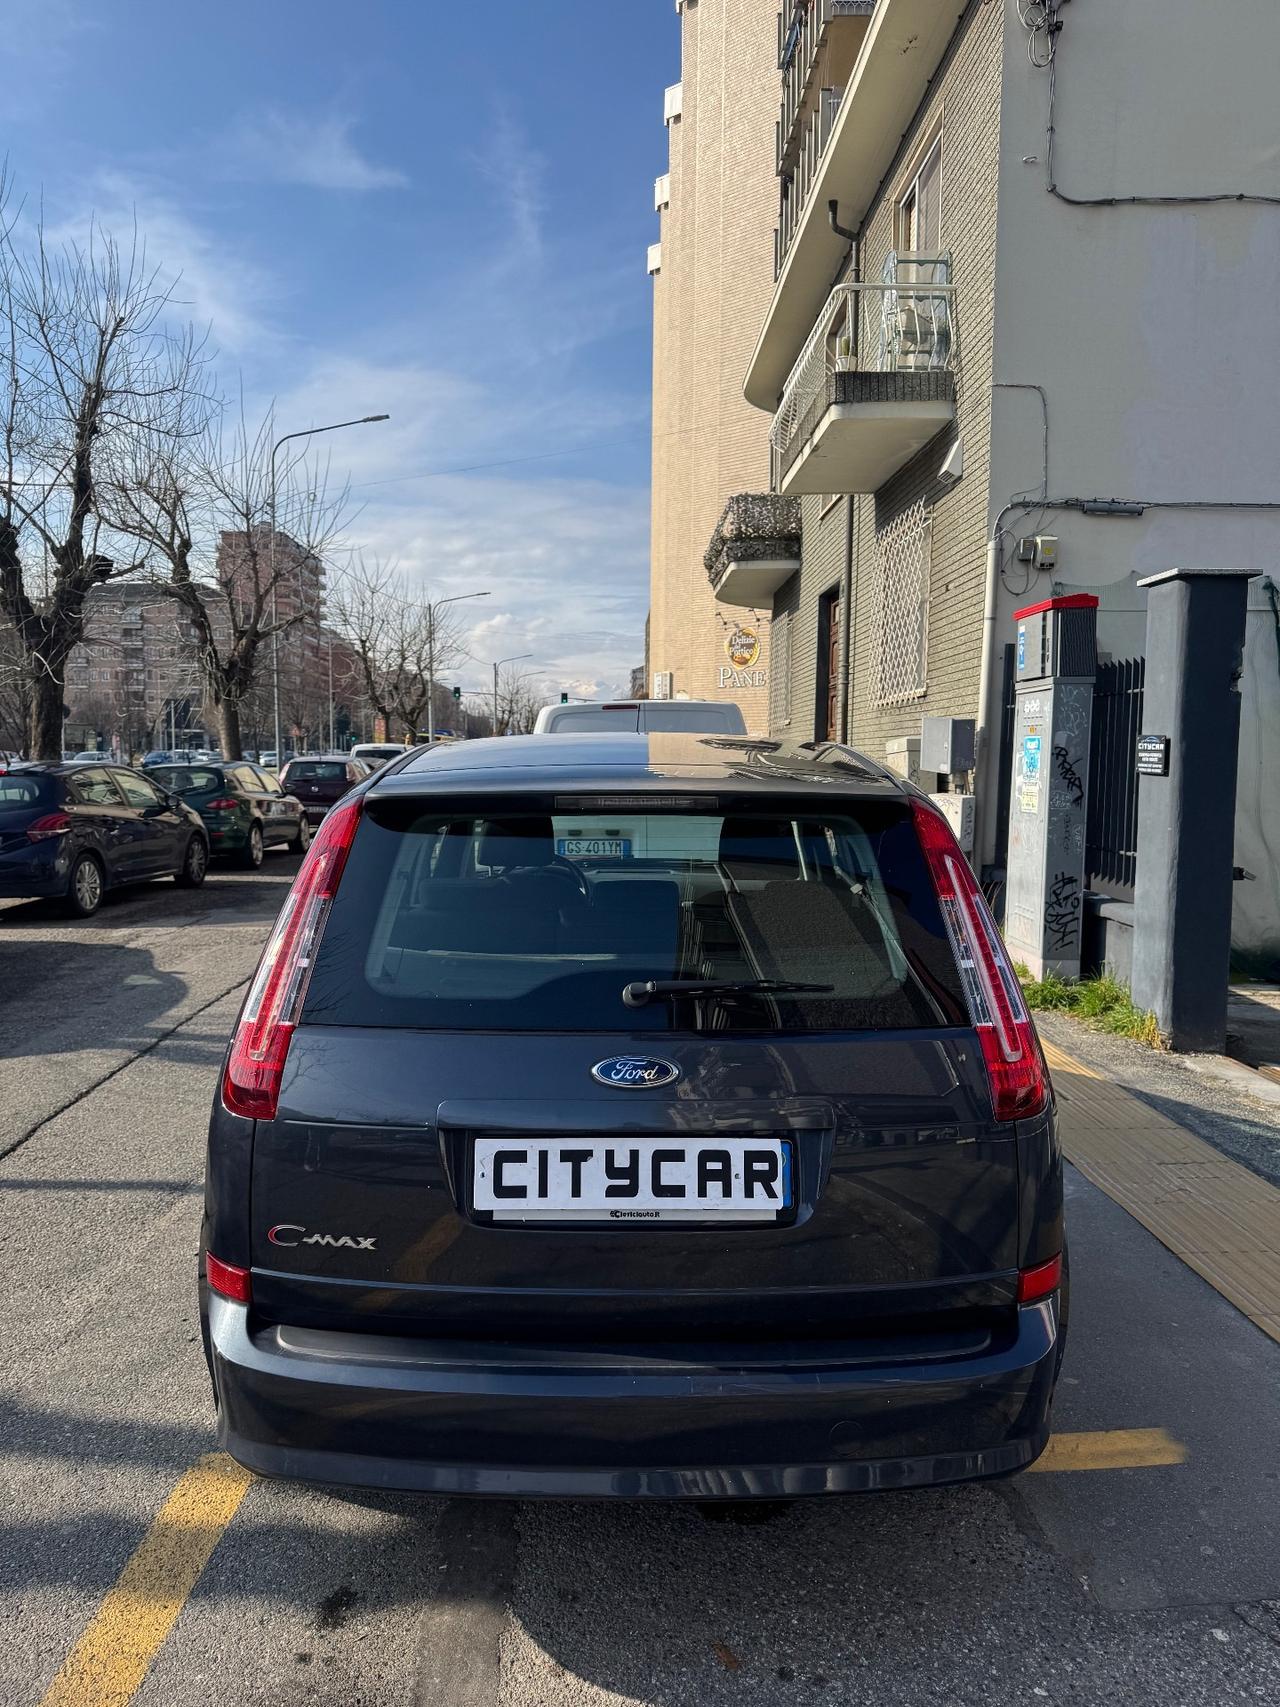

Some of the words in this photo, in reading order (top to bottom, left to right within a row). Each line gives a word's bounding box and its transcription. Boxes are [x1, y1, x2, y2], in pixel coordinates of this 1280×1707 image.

[732, 635, 755, 645] Delizie
[729, 647, 754, 656] Portico
[718, 667, 766, 688] PANE
[1138, 743, 1165, 751] CITYCAR
[611, 1061, 659, 1080] Ford
[493, 1149, 779, 1199] CITYCAR
